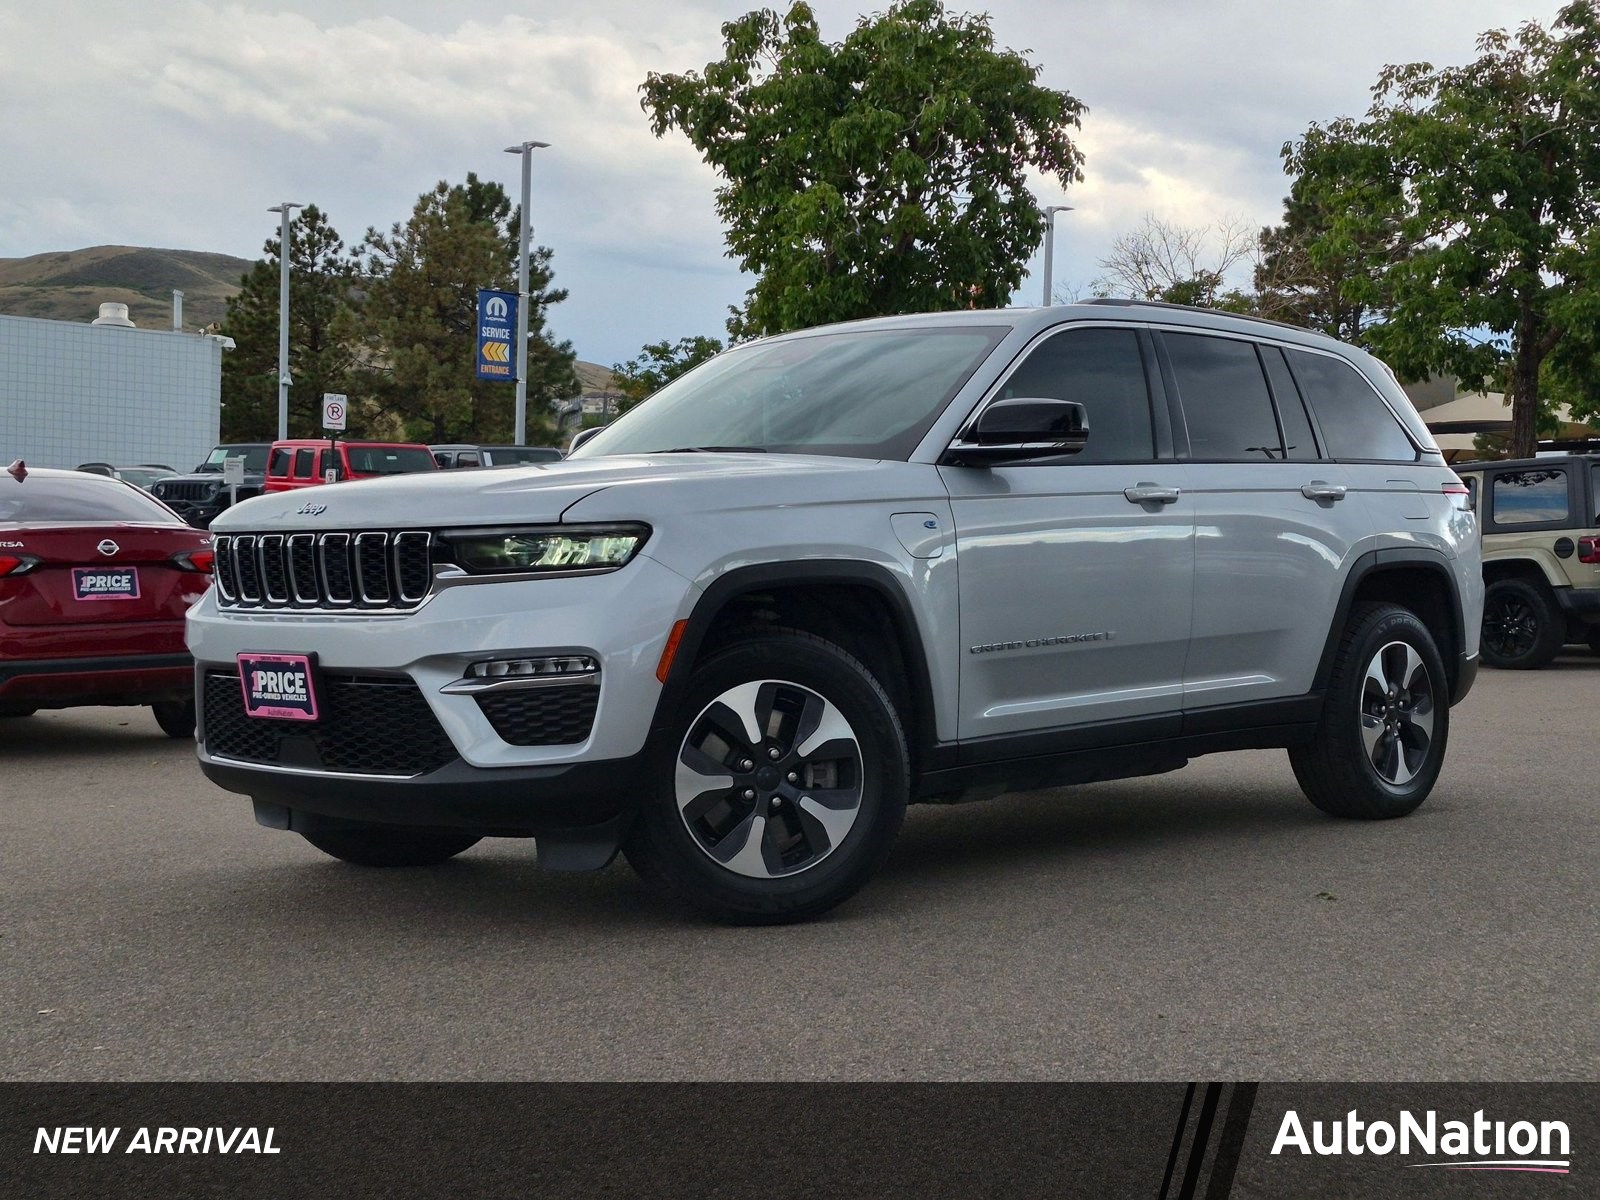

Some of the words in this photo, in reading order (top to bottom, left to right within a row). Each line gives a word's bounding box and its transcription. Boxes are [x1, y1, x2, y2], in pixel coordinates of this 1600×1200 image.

[482, 326, 510, 339] SERVICE
[481, 364, 510, 375] ENTRANCE
[296, 502, 327, 516] Jeep
[1025, 632, 1104, 648] CHEROKEE
[252, 692, 281, 700] PRE-OWNED
[282, 694, 307, 702] VEHICLES
